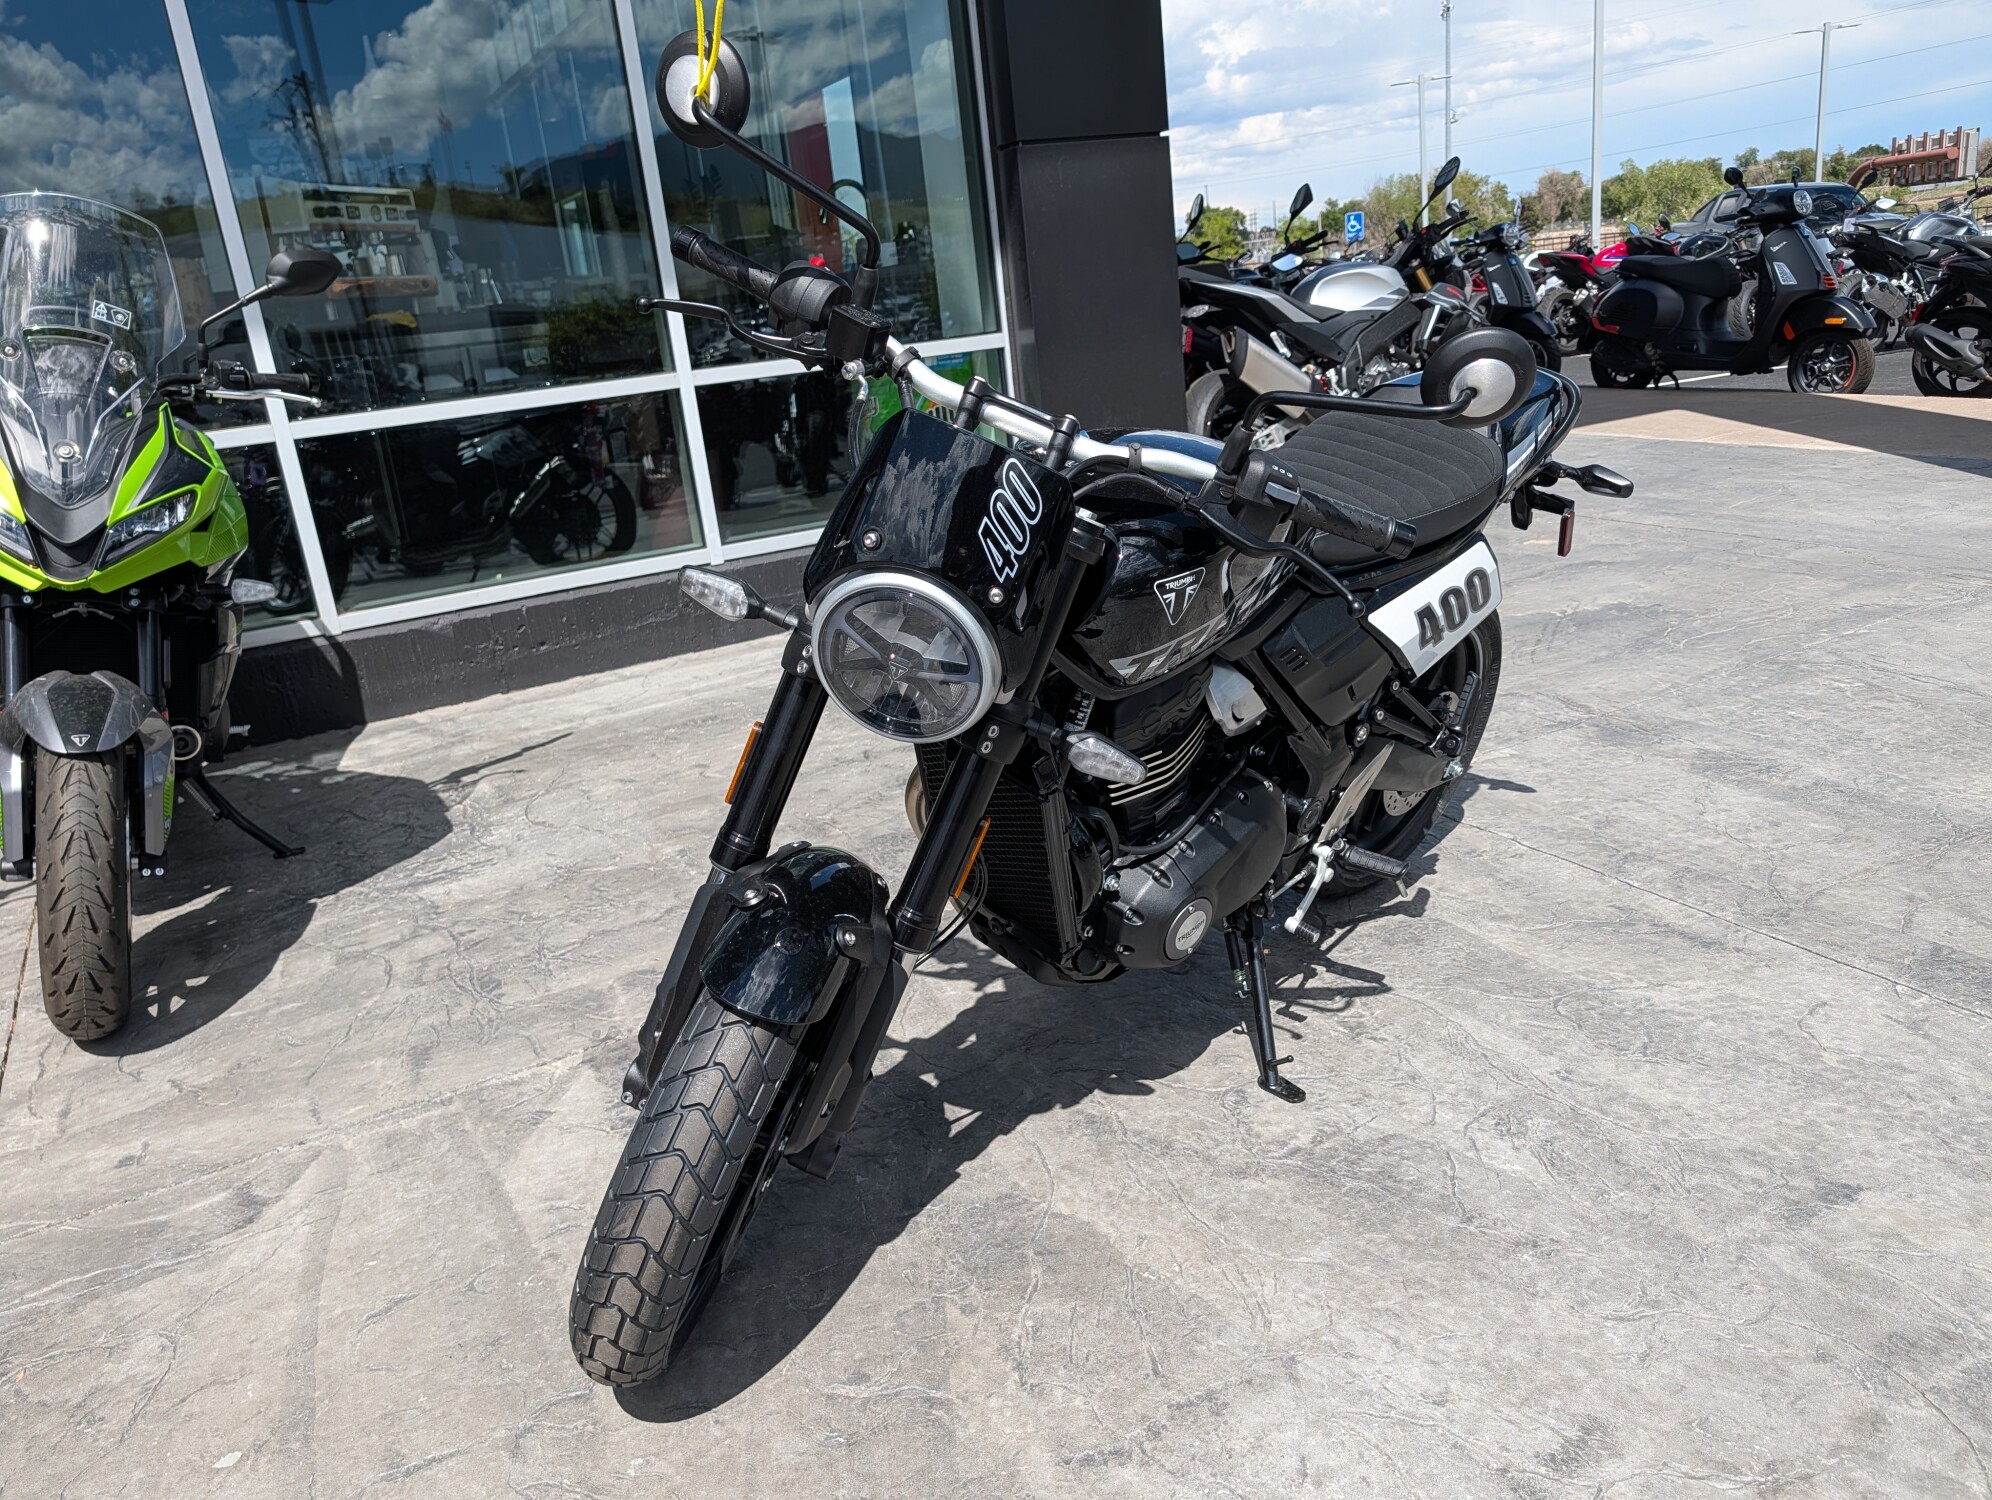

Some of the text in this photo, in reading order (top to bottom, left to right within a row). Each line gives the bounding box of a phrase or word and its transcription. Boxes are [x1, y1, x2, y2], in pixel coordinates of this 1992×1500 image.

[978, 457, 1043, 583] 400
[1165, 575, 1196, 590] TRIUMPH
[1413, 566, 1492, 651] 400
[1177, 918, 1205, 943] TRIUMPH
